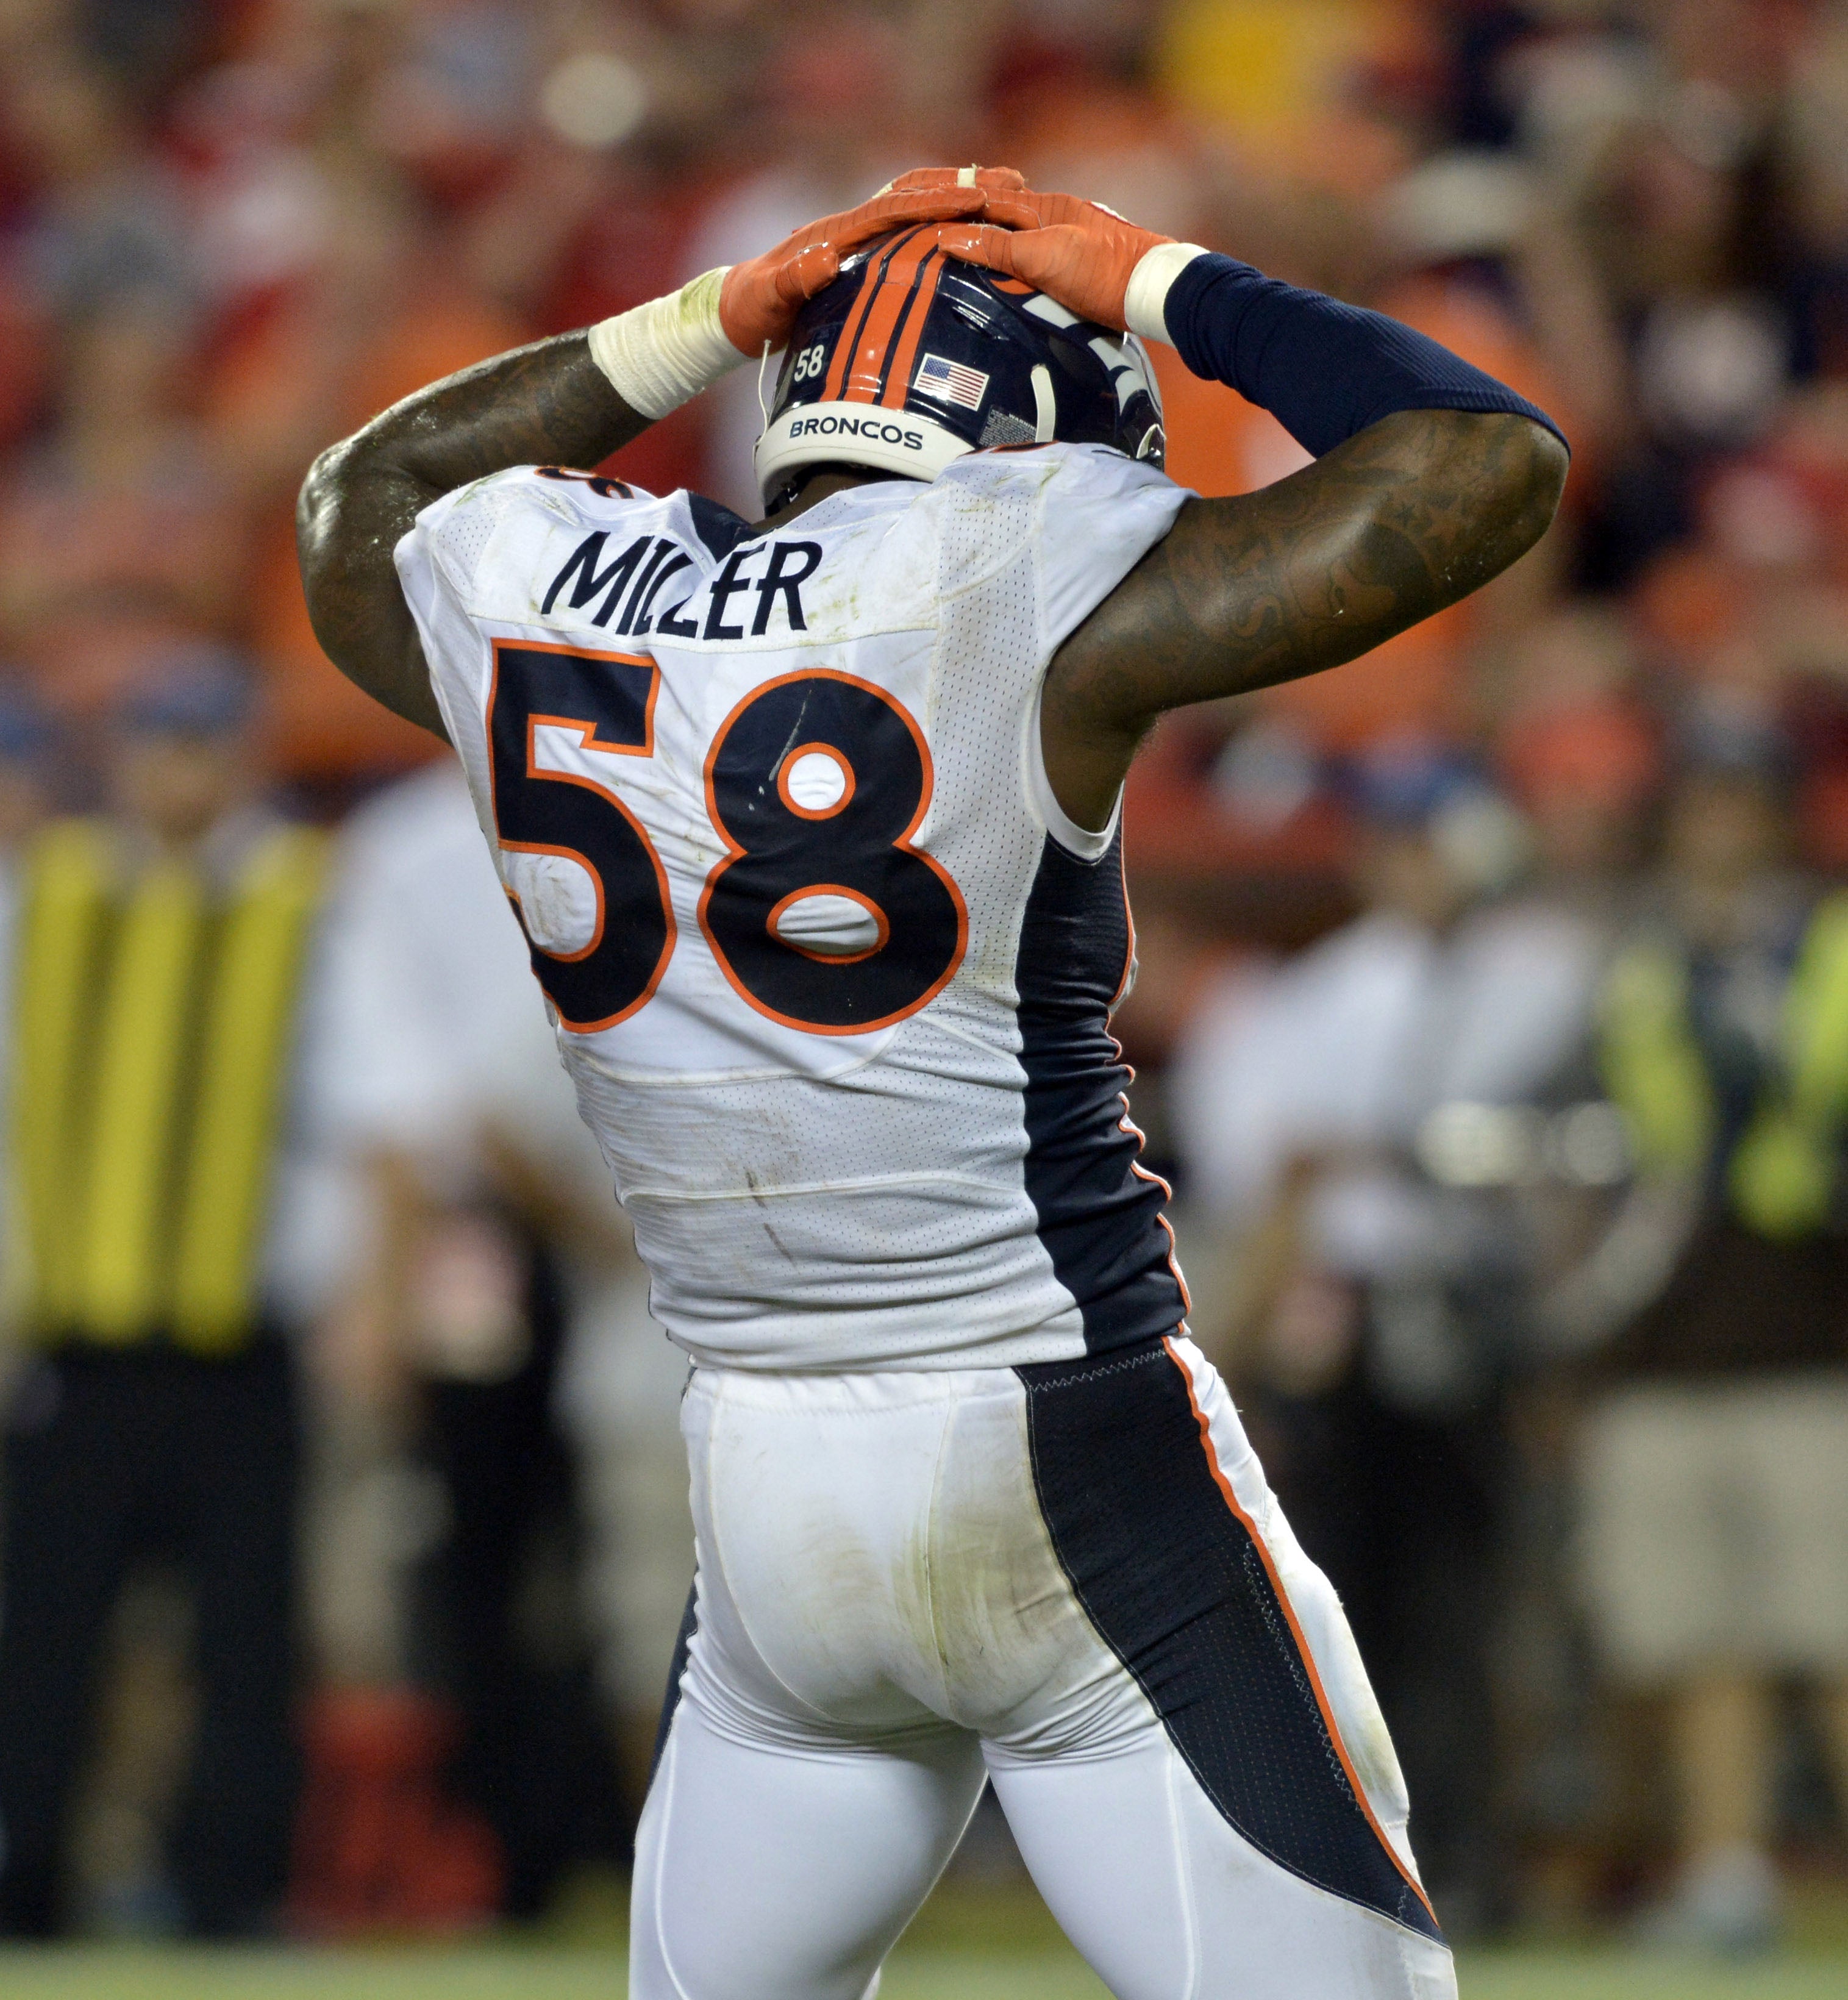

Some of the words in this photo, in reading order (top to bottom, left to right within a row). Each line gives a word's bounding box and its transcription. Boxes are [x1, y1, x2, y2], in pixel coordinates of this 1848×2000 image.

[794, 345, 824, 382] 58
[790, 416, 923, 451] BRONCOS
[541, 530, 823, 641] MILLER
[487, 637, 969, 1036] 58
